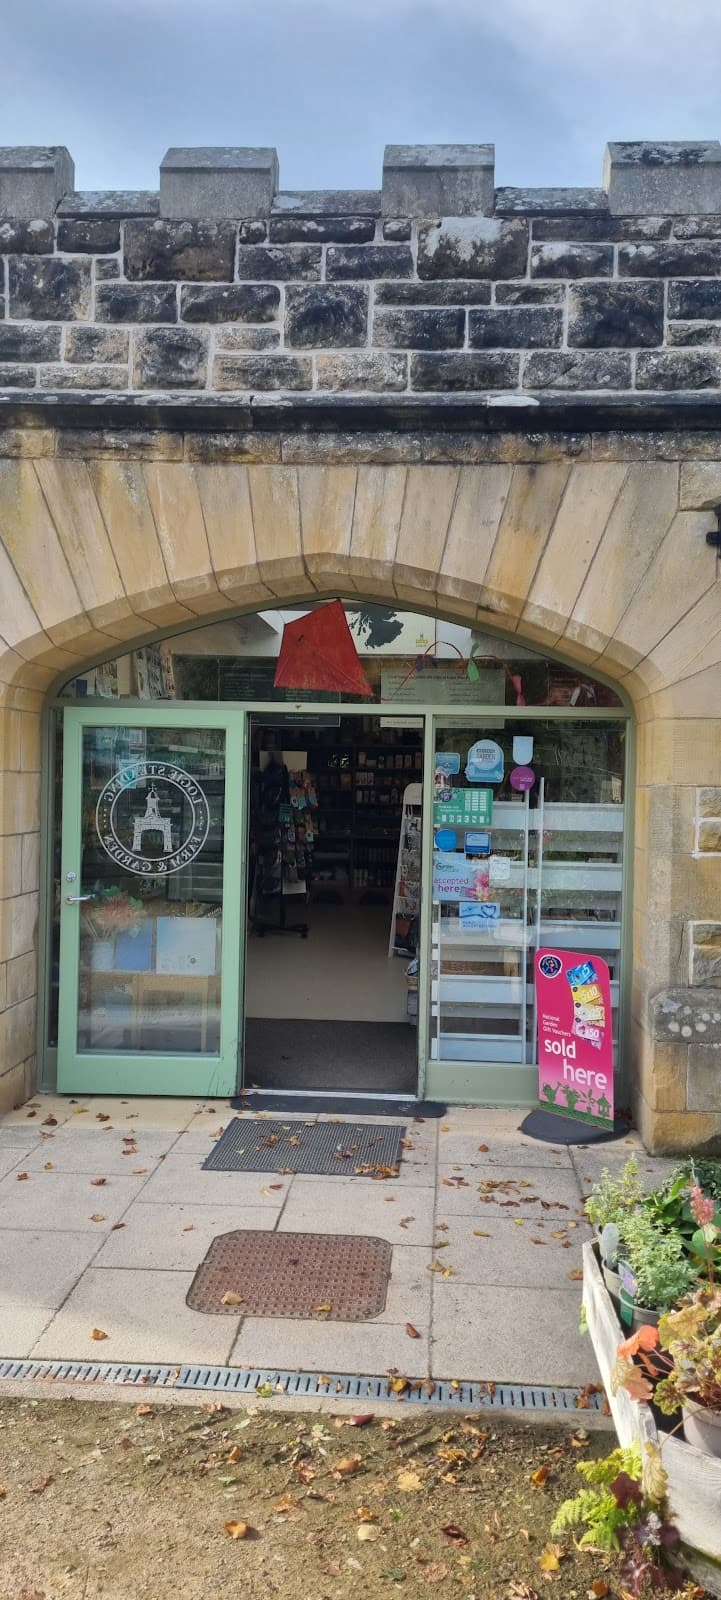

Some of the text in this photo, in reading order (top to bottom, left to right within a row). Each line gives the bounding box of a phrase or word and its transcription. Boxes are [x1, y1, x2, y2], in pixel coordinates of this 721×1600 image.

[434, 877, 469, 887] accepted
[438, 884, 460, 893] here
[542, 1013, 560, 1022] National
[542, 1019, 558, 1028] Garden
[542, 1025, 572, 1038] Gift Vouchers
[544, 1038, 577, 1059] sold
[563, 1058, 608, 1090] here
